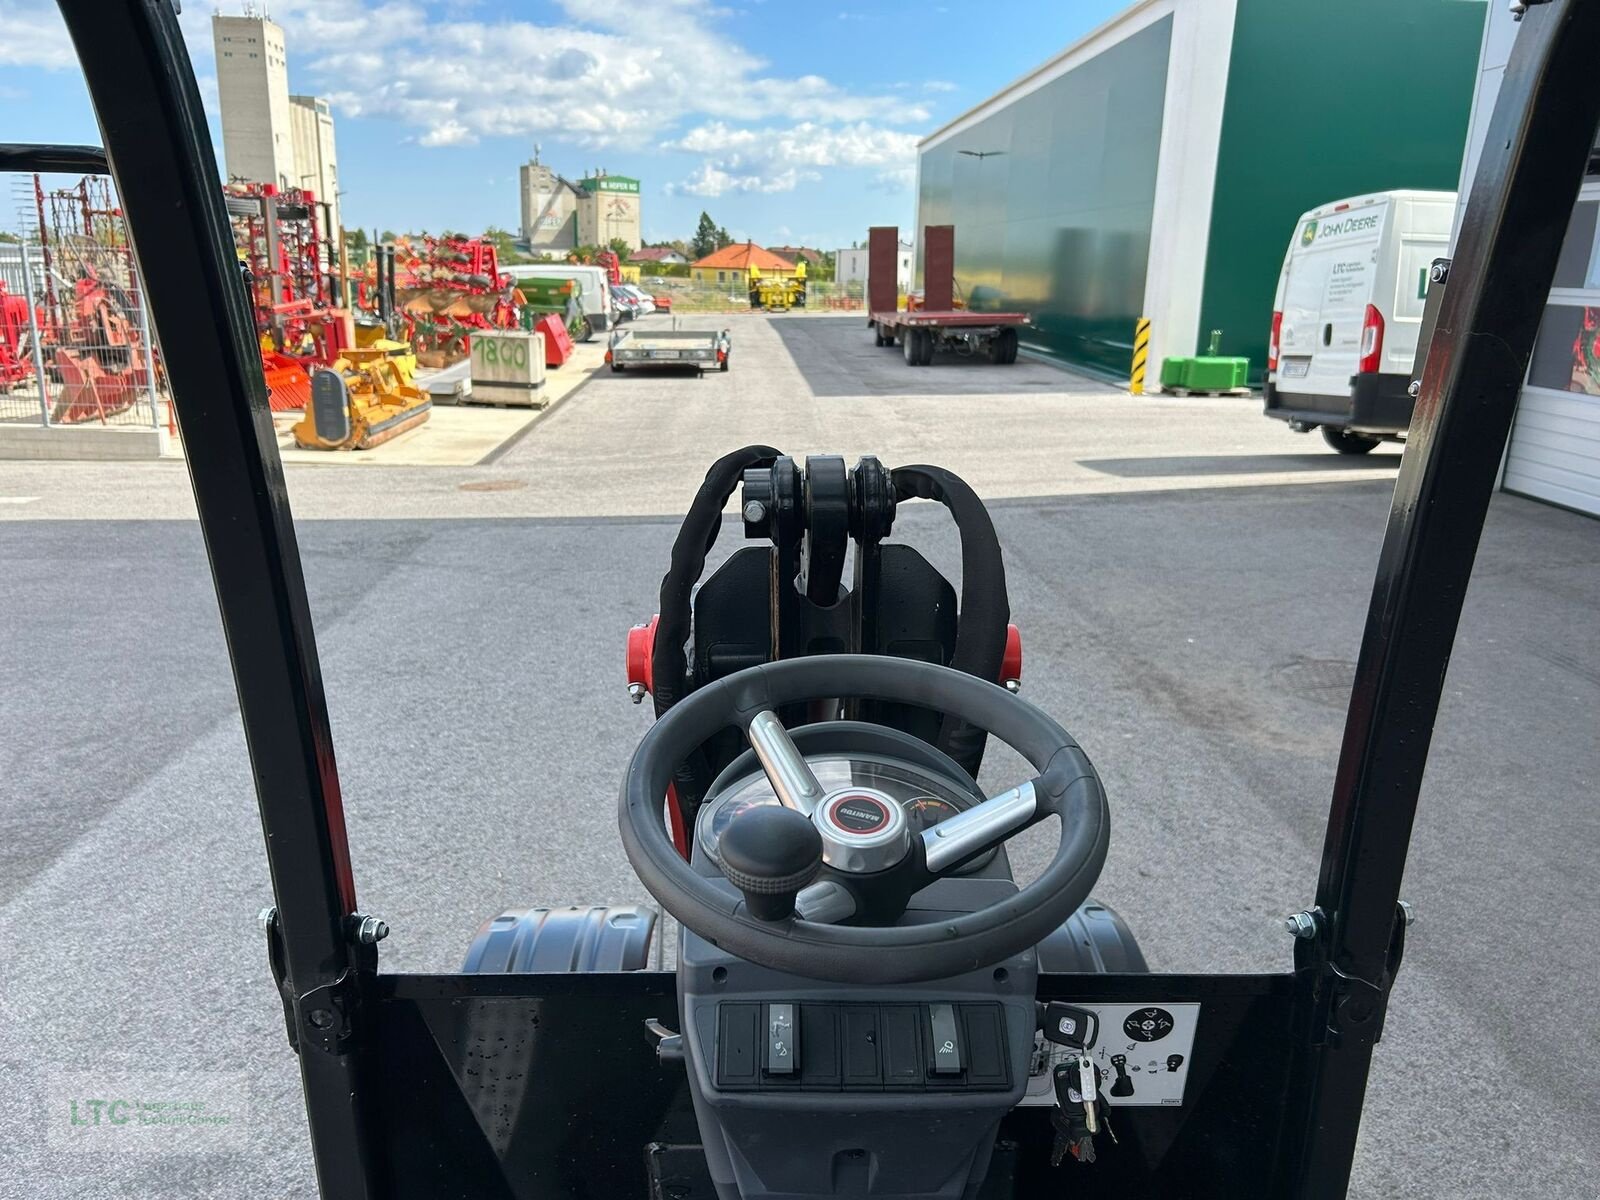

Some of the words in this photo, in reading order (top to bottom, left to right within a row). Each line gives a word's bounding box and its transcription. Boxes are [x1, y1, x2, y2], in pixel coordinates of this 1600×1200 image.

[1318, 221, 1344, 238] JOHN
[1343, 215, 1379, 233] DEERE
[1332, 263, 1346, 274] LTC
[472, 336, 526, 369] 1800
[840, 807, 880, 821] MANITOU
